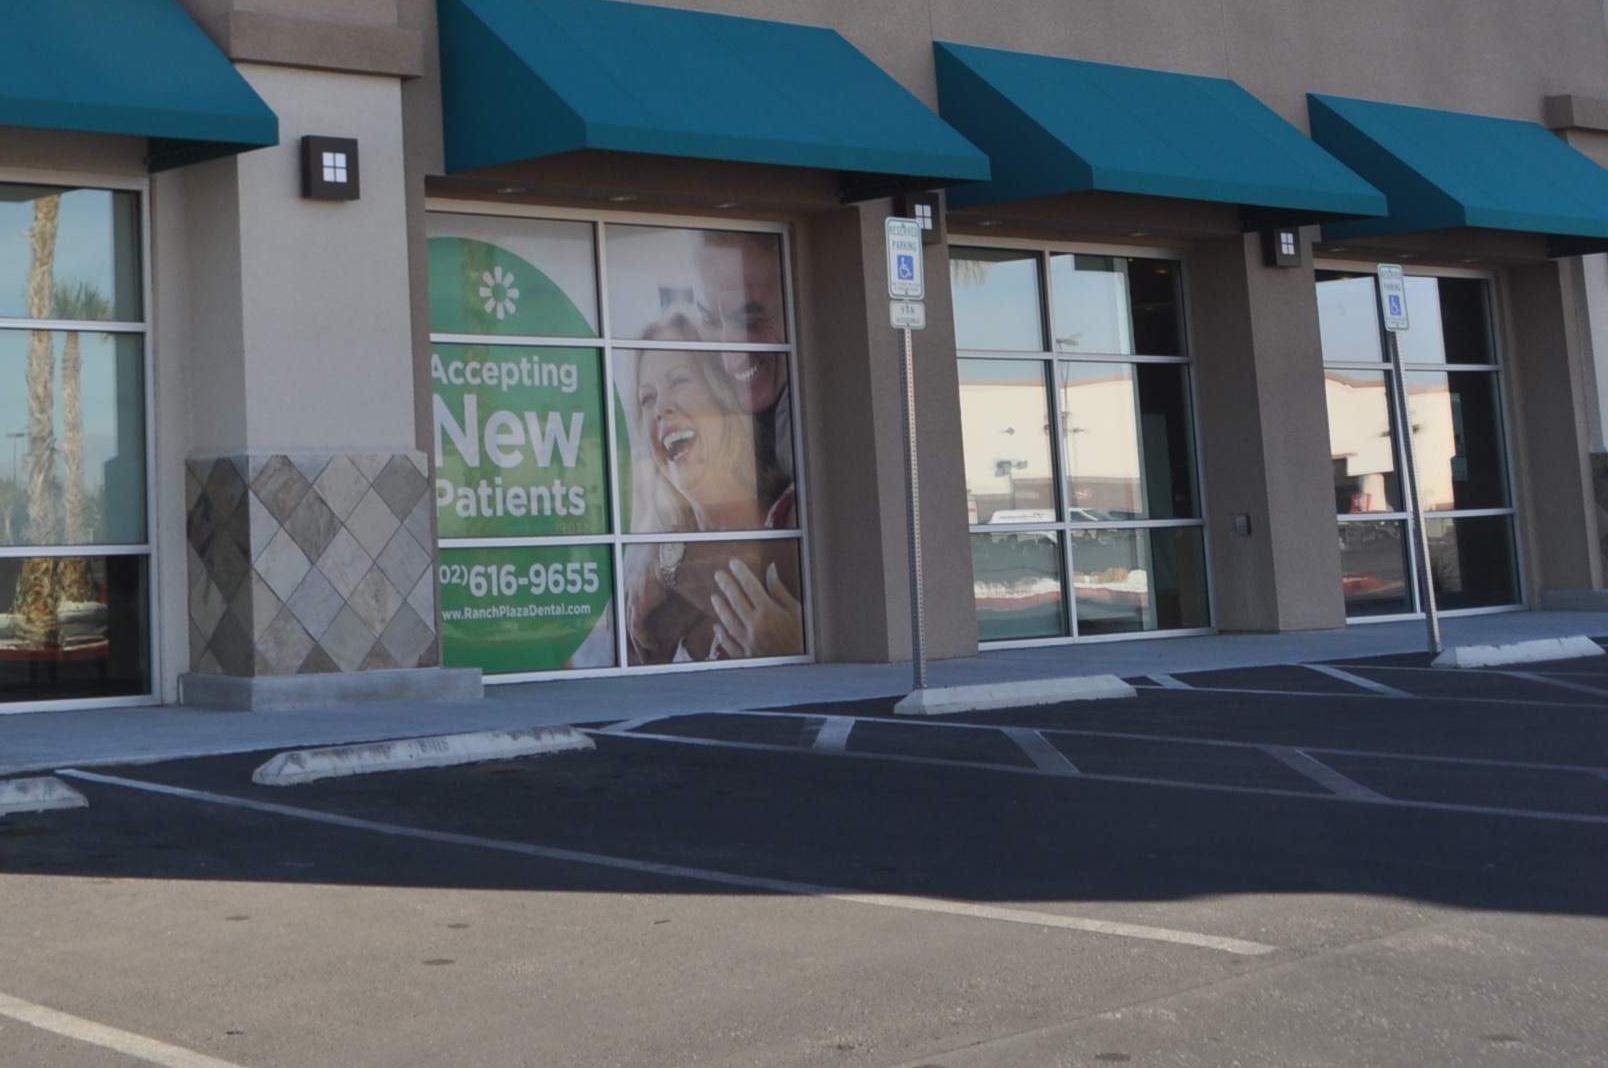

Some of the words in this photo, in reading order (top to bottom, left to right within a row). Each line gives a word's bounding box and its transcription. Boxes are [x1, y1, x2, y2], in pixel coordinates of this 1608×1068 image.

[889, 225, 918, 237] RESERVED
[892, 240, 917, 252] PARKING
[900, 305, 915, 314] VAN
[432, 353, 578, 394] Accepting
[432, 393, 585, 469] New
[437, 477, 586, 518] Patients
